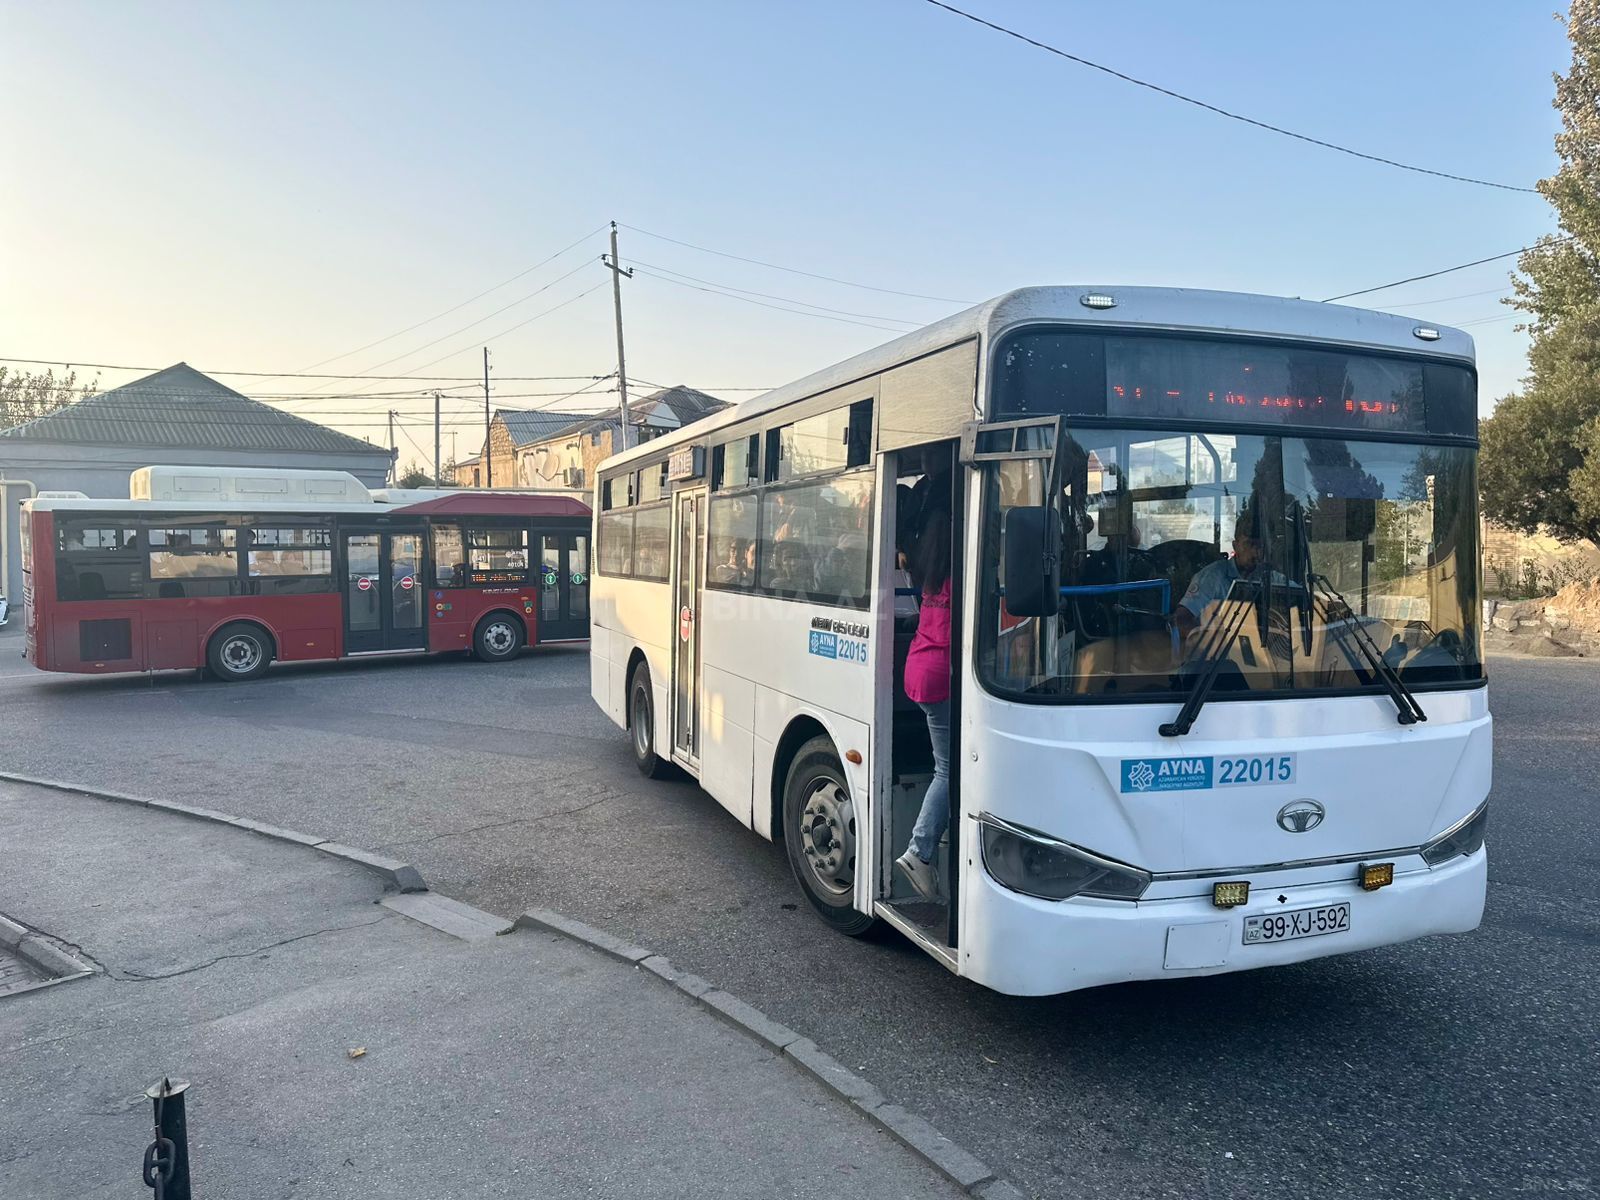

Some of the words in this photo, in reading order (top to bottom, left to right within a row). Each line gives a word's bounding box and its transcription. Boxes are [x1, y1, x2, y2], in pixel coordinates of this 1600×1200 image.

[819, 634, 835, 647] AYNA
[838, 639, 867, 662] 22015
[1158, 759, 1206, 776] AYNA
[1219, 757, 1292, 784] 22015
[1248, 930, 1259, 939] AZ
[1262, 906, 1347, 939] 99-XJ-592
